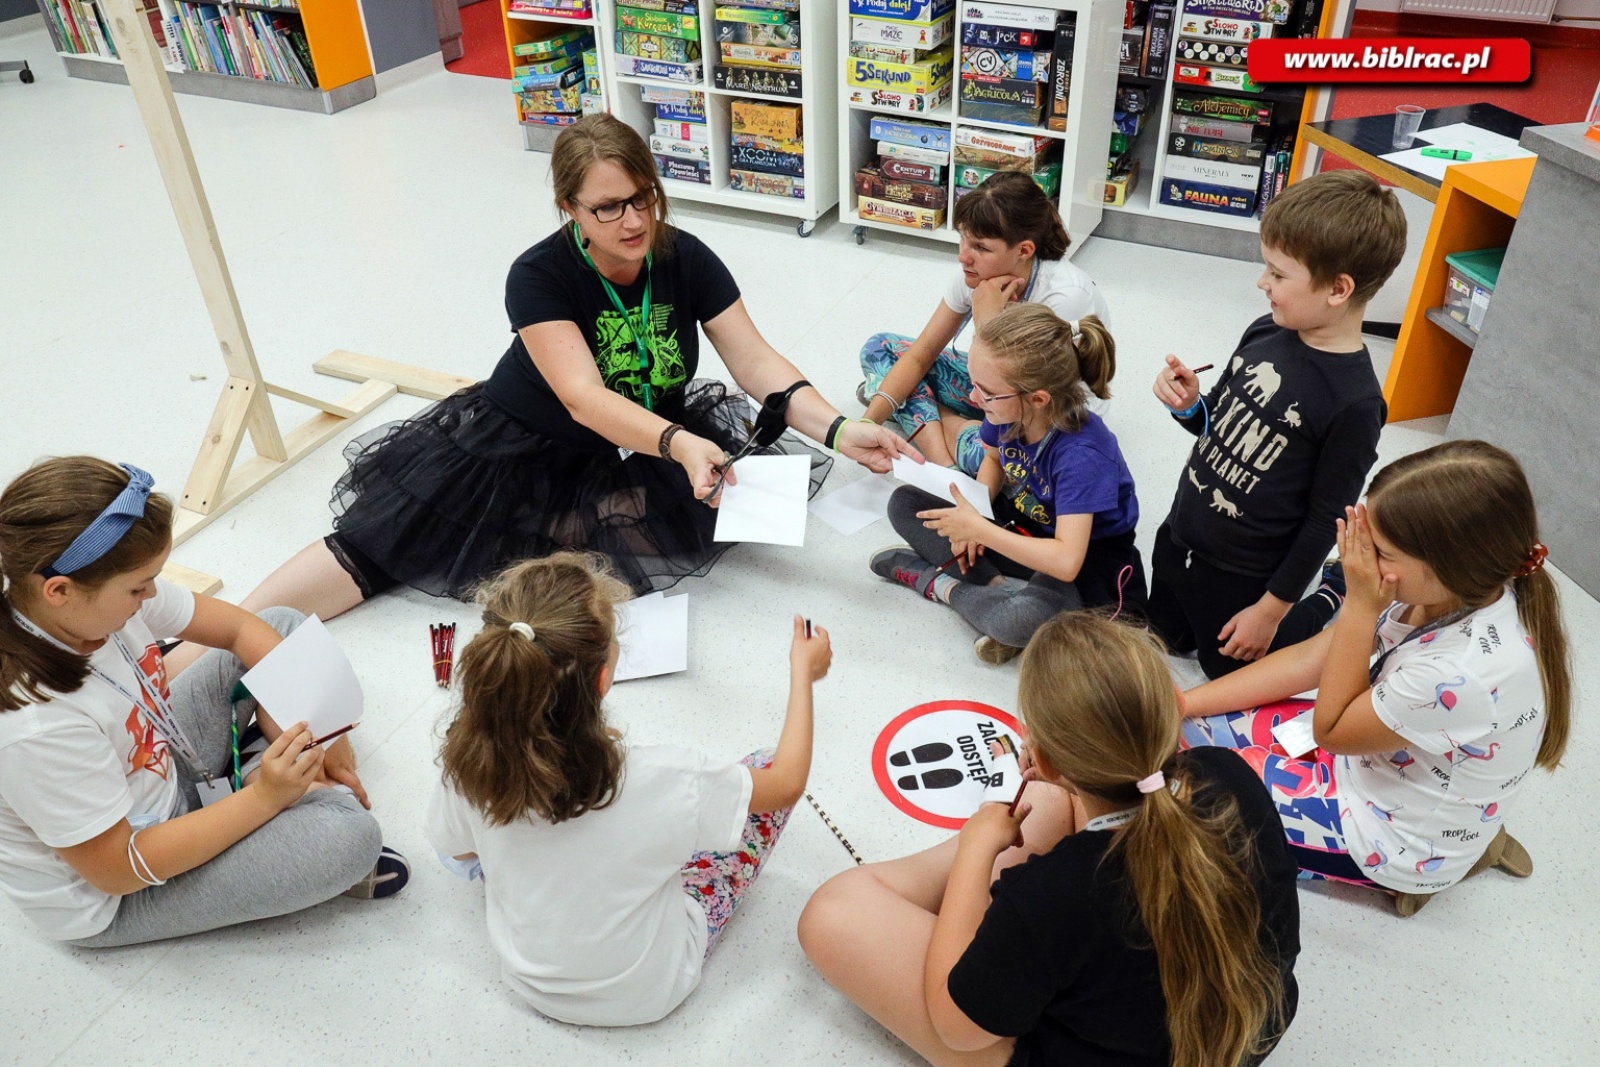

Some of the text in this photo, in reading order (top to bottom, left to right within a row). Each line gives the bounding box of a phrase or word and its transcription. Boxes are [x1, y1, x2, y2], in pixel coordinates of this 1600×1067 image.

[979, 55, 993, 68] CV
[855, 60, 868, 82] 5
[726, 81, 789, 94] MARE NOSTRUM
[1055, 58, 1066, 101] ZBRODNI
[974, 87, 1021, 102] AGRICOLA
[739, 147, 777, 163] XCOM
[893, 163, 927, 175] CENTURY
[1184, 190, 1229, 207] FAUNA
[1214, 396, 1289, 472] KIND
[1206, 445, 1261, 495] PLANET
